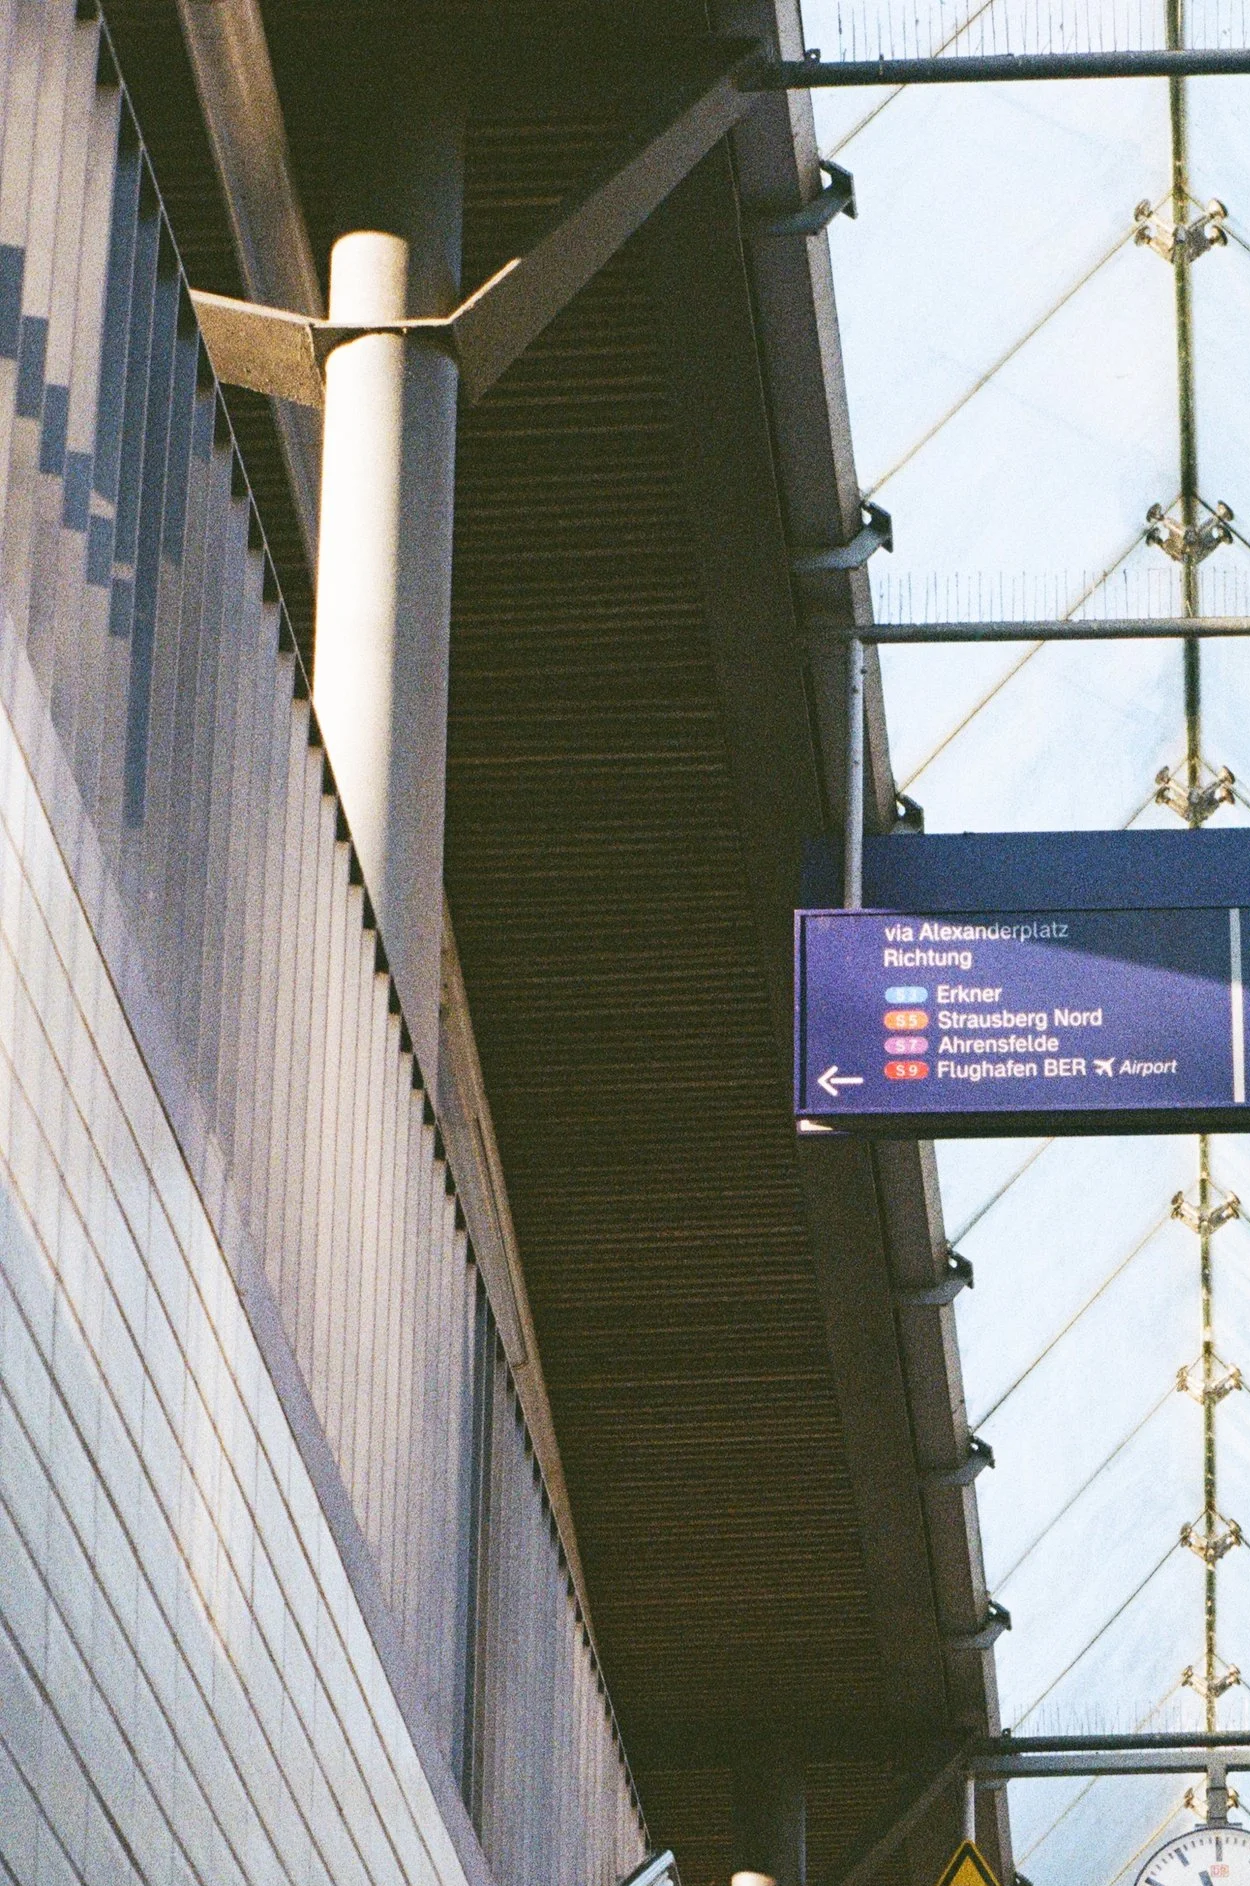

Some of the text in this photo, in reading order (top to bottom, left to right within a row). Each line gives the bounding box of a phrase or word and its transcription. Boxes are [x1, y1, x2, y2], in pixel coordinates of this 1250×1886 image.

[885, 922, 1069, 946] via Alexanderplatz
[884, 948, 973, 970] Richtung
[937, 985, 1003, 1004] Erkner
[937, 1010, 1049, 1031] Strausberg
[1054, 1009, 1103, 1027] Nord
[938, 1035, 1060, 1054] Ahrensfelde
[937, 1060, 1039, 1082] Flughafen
[1044, 1060, 1087, 1077] BER
[1119, 1058, 1178, 1078] Airport
